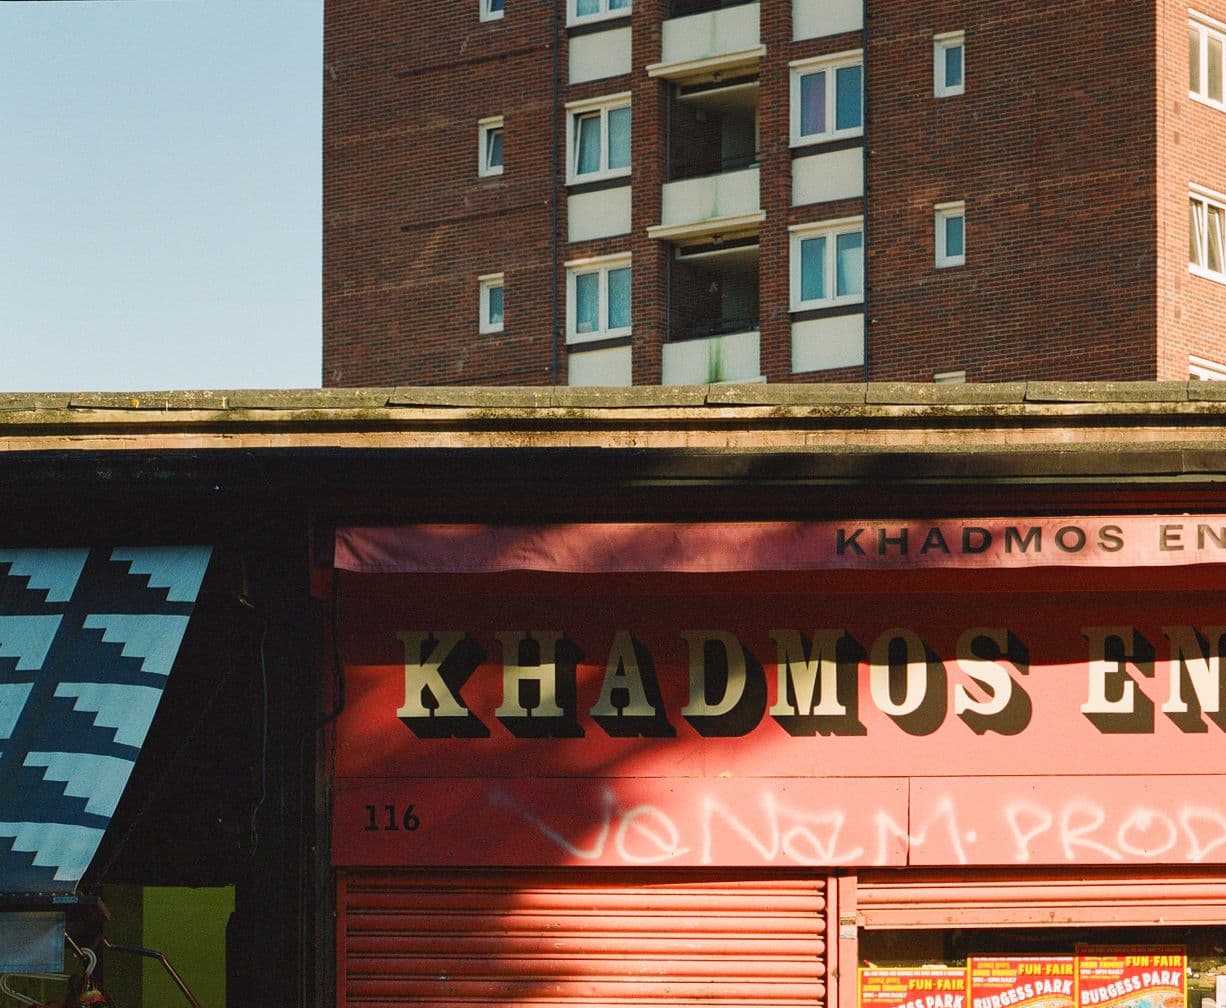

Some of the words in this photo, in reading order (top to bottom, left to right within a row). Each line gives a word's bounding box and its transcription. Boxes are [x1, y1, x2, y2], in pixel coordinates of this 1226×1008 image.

[835, 524, 1125, 556] KHADMOS
[395, 627, 1034, 739] KHADMOS
[364, 804, 421, 832] 116
[1018, 963, 1073, 976] FUN-FAIR
[1125, 955, 1182, 967] FUN-FAIR
[909, 978, 965, 991] FUN-FAIR
[1034, 978, 1073, 995] PARK
[1081, 975, 1141, 1005] BURGESS
[1141, 970, 1182, 987] PARK
